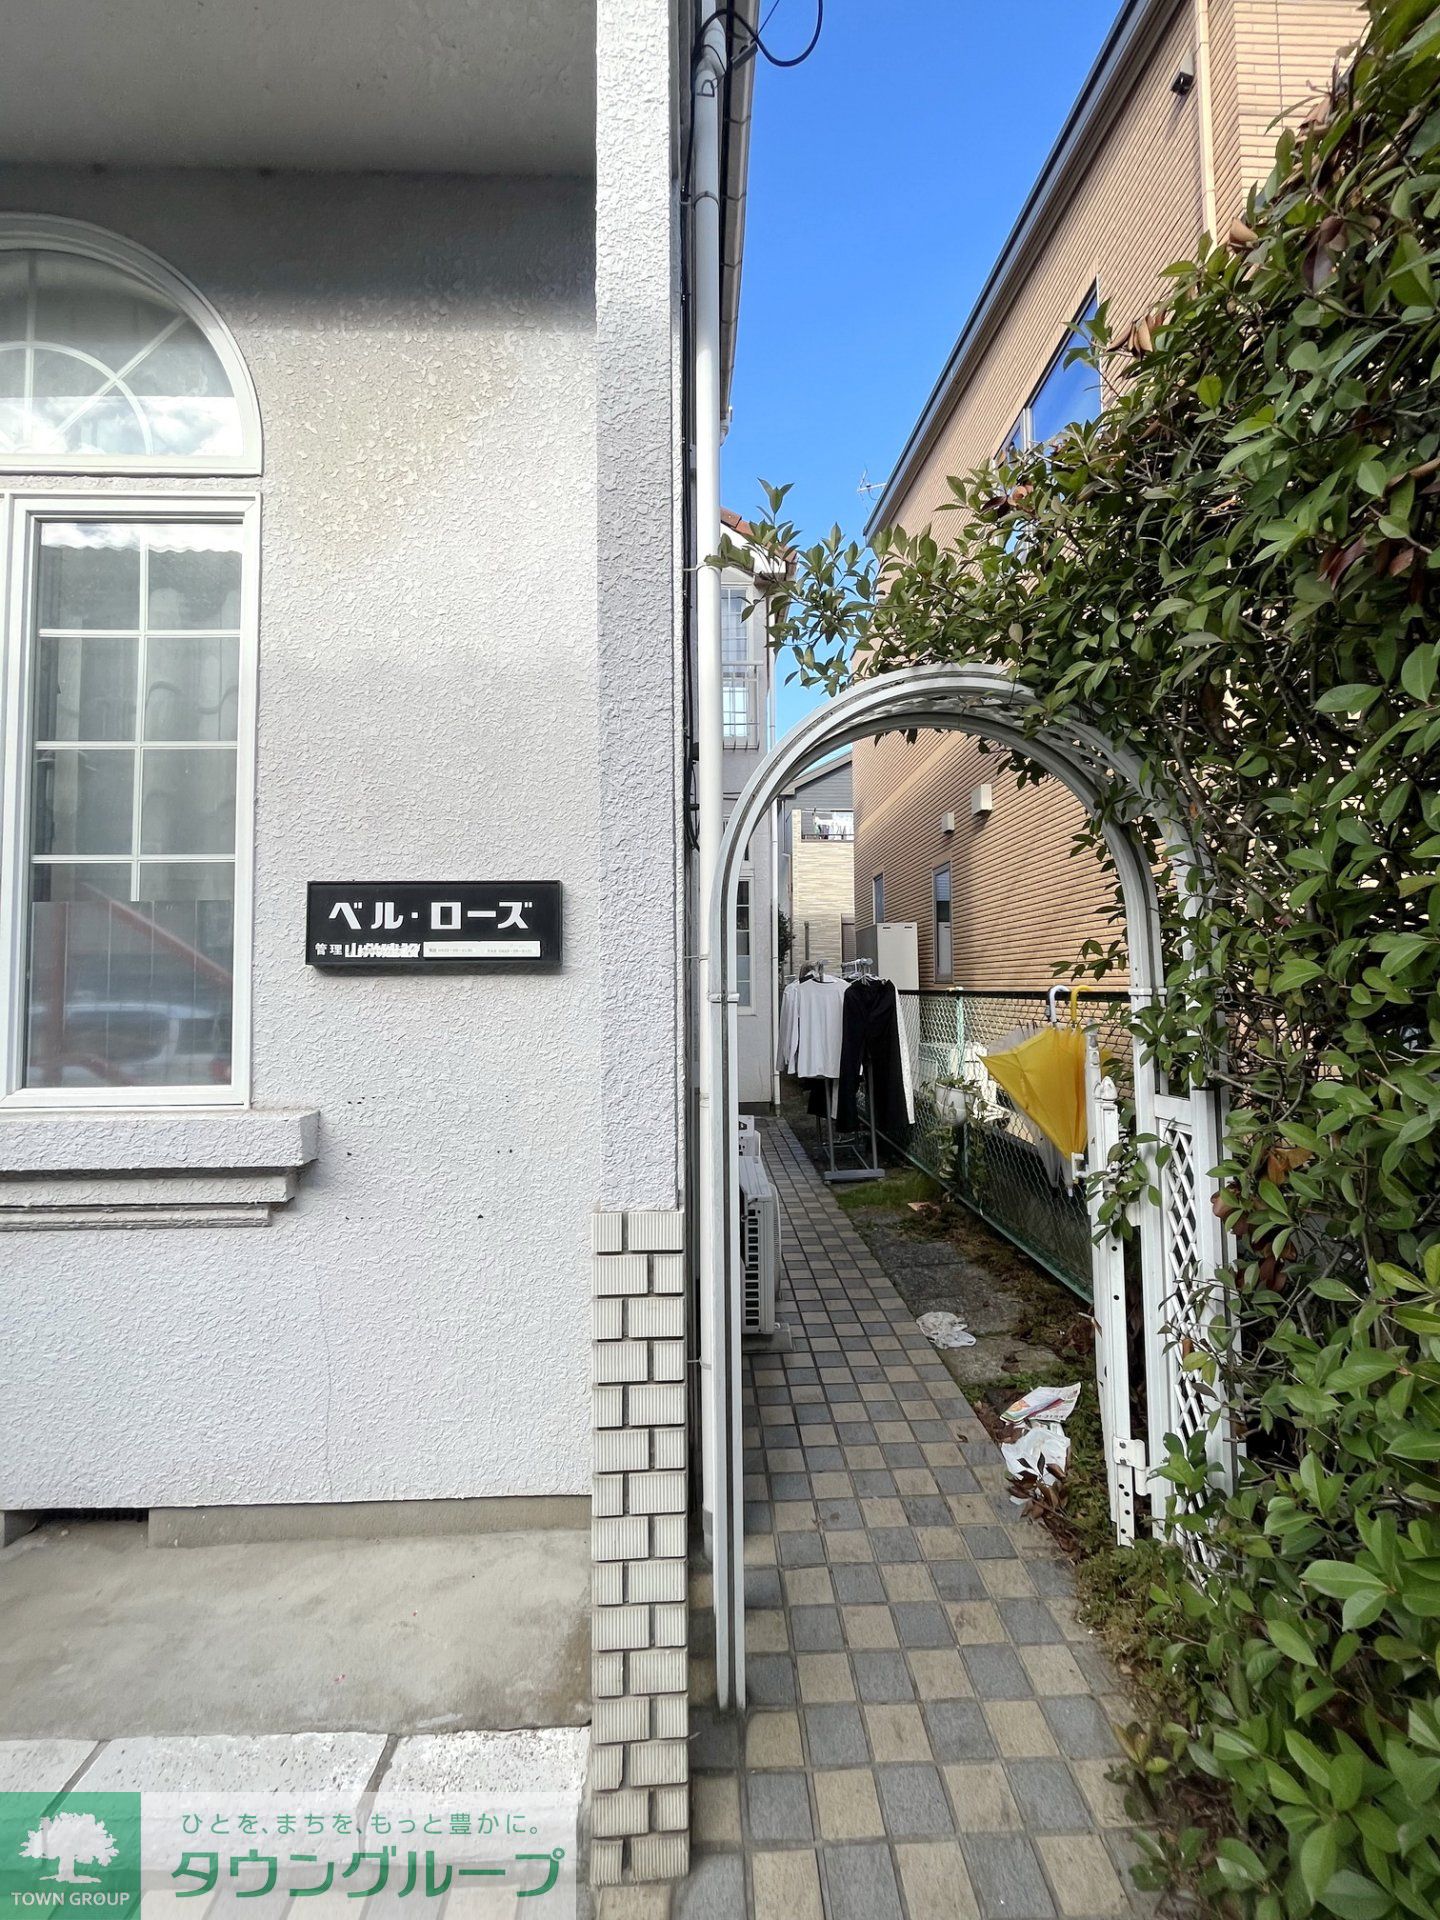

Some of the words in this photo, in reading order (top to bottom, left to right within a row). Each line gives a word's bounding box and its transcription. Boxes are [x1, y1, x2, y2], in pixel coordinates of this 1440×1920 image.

[328, 901, 533, 930] ベル・ローズ
[314, 942, 343, 956] 管理
